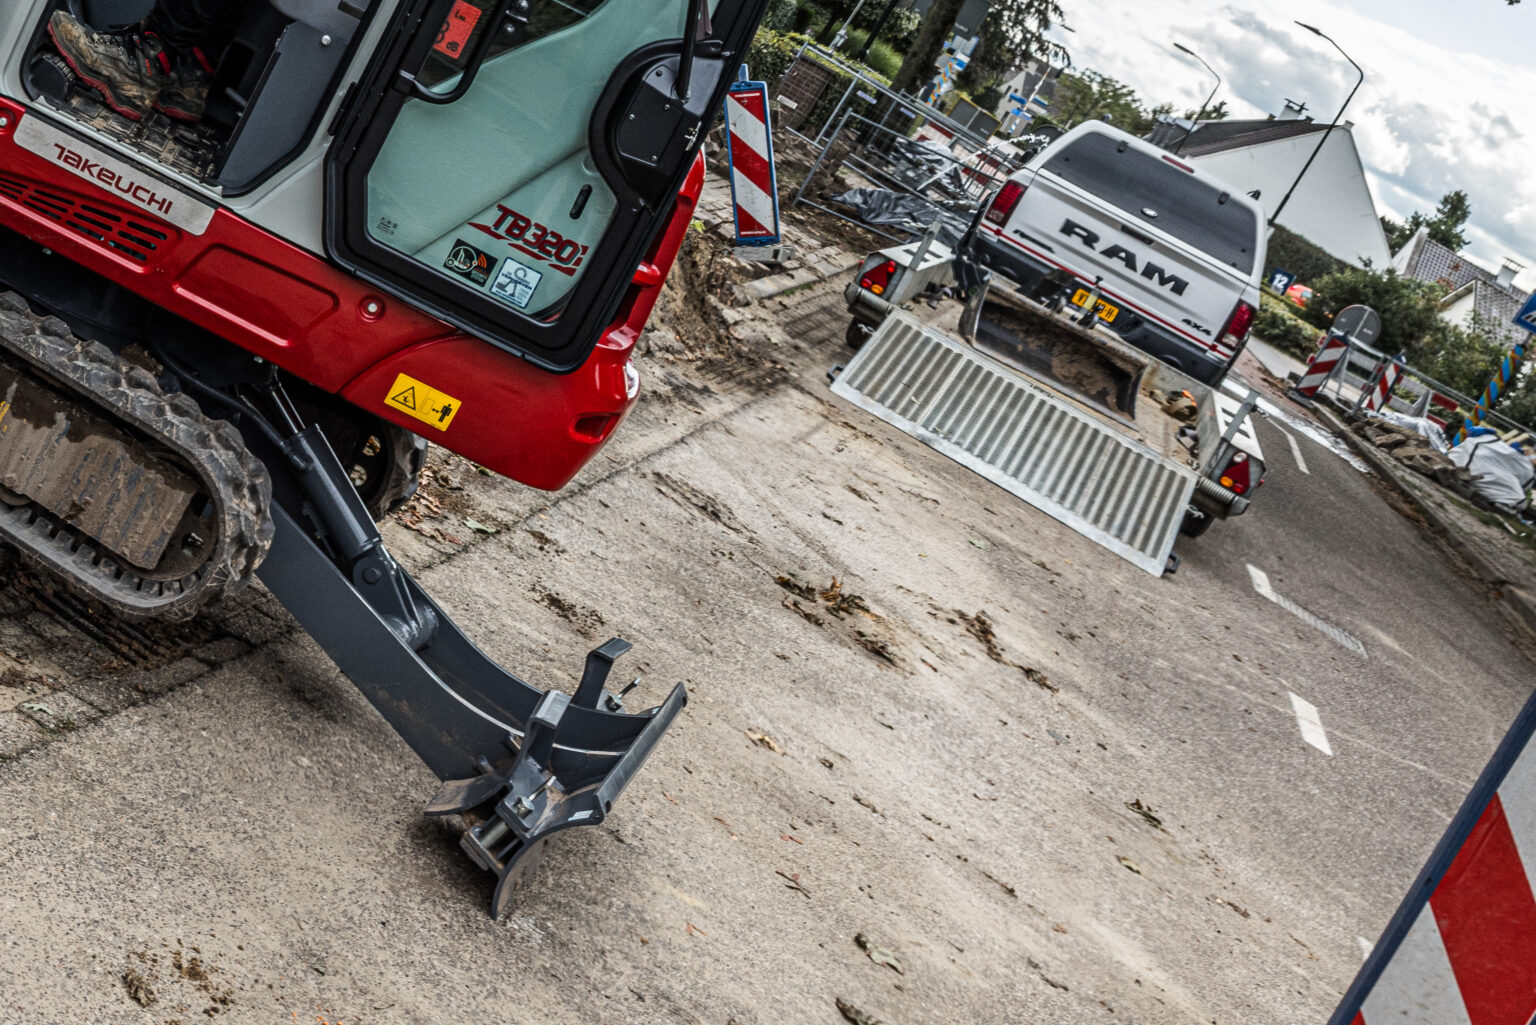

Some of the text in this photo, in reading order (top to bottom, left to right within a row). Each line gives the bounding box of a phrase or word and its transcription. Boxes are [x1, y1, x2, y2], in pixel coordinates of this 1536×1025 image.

[446, 40, 460, 53] dB
[1059, 218, 1189, 296] RAM
[1272, 274, 1289, 289] 12
